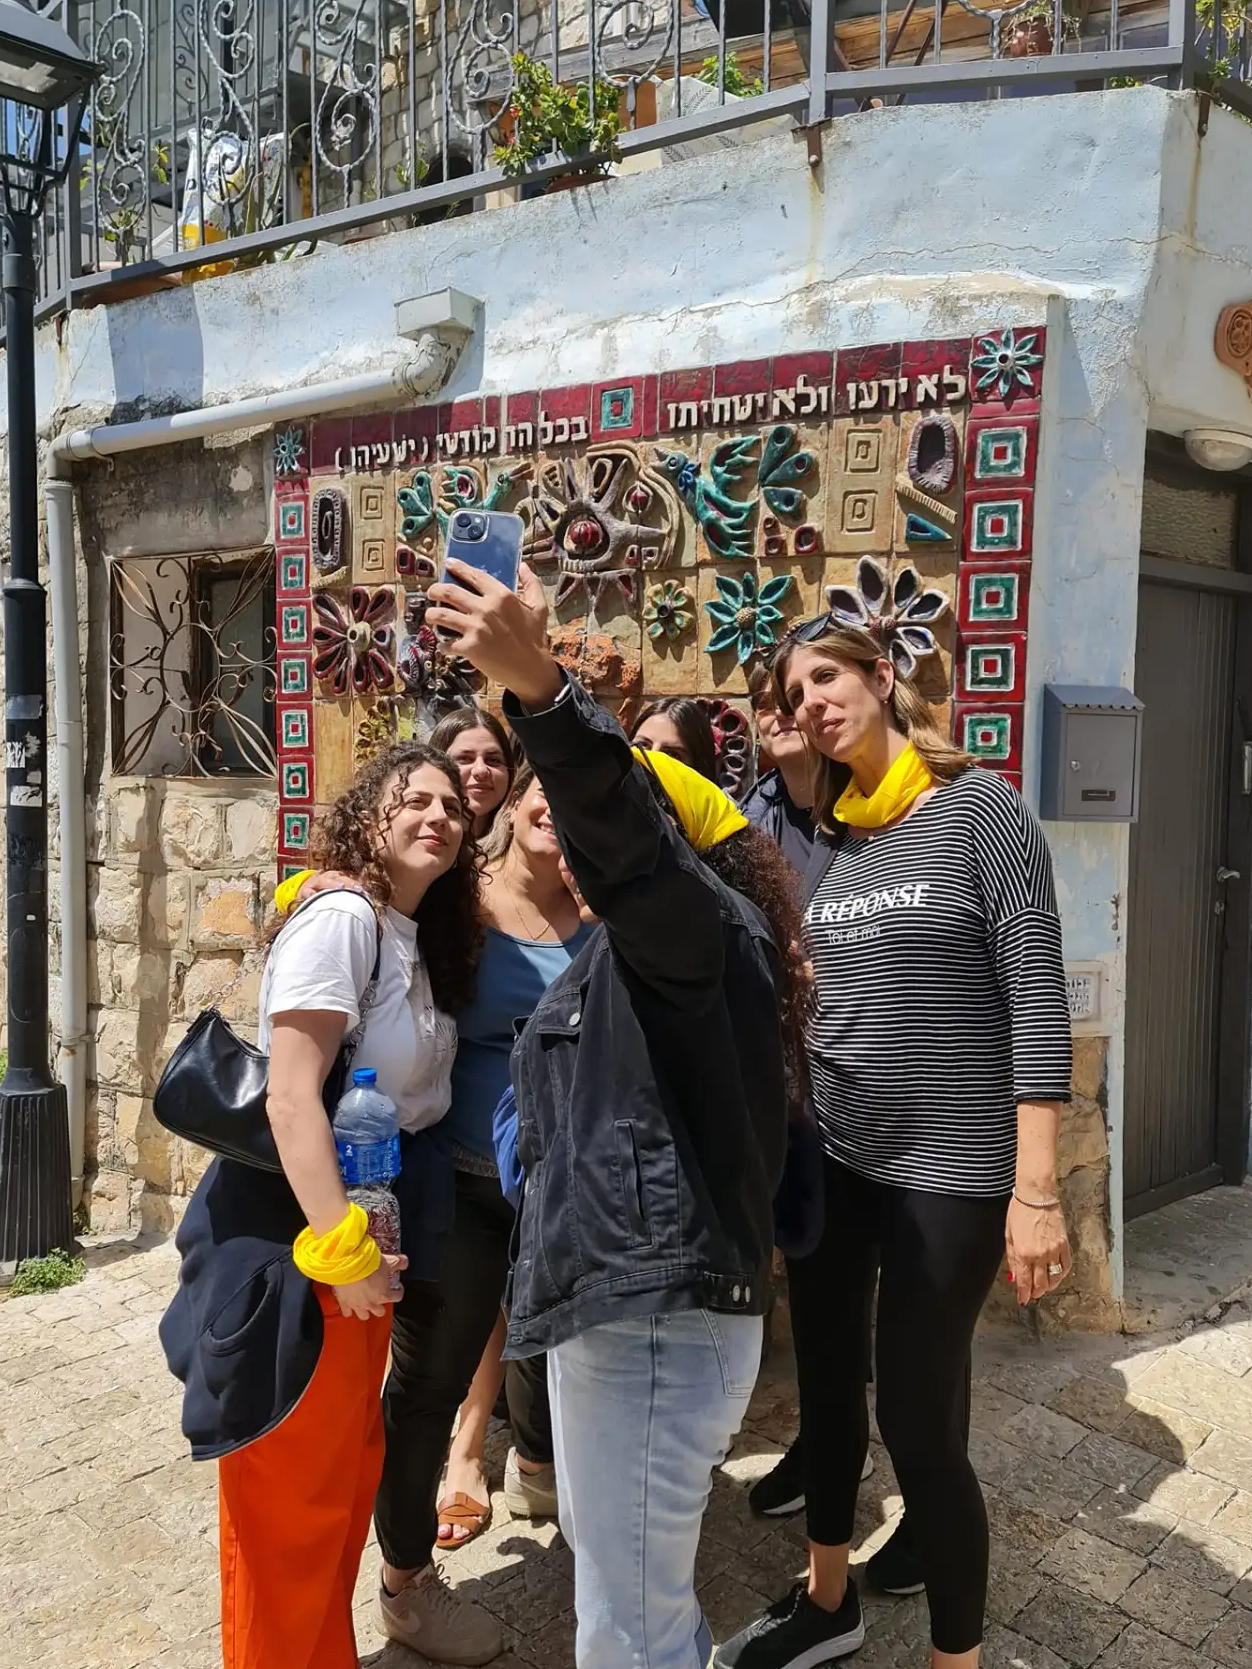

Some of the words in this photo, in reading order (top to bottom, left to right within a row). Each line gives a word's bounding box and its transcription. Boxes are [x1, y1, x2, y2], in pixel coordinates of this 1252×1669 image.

[772, 374, 830, 416] ולא
[846, 377, 909, 411] ירעו
[916, 364, 967, 403] לא
[540, 411, 589, 445] בכל
[667, 390, 767, 429] ישחיתו
[504, 422, 533, 448] הר
[820, 884, 930, 923] RÉPONSE
